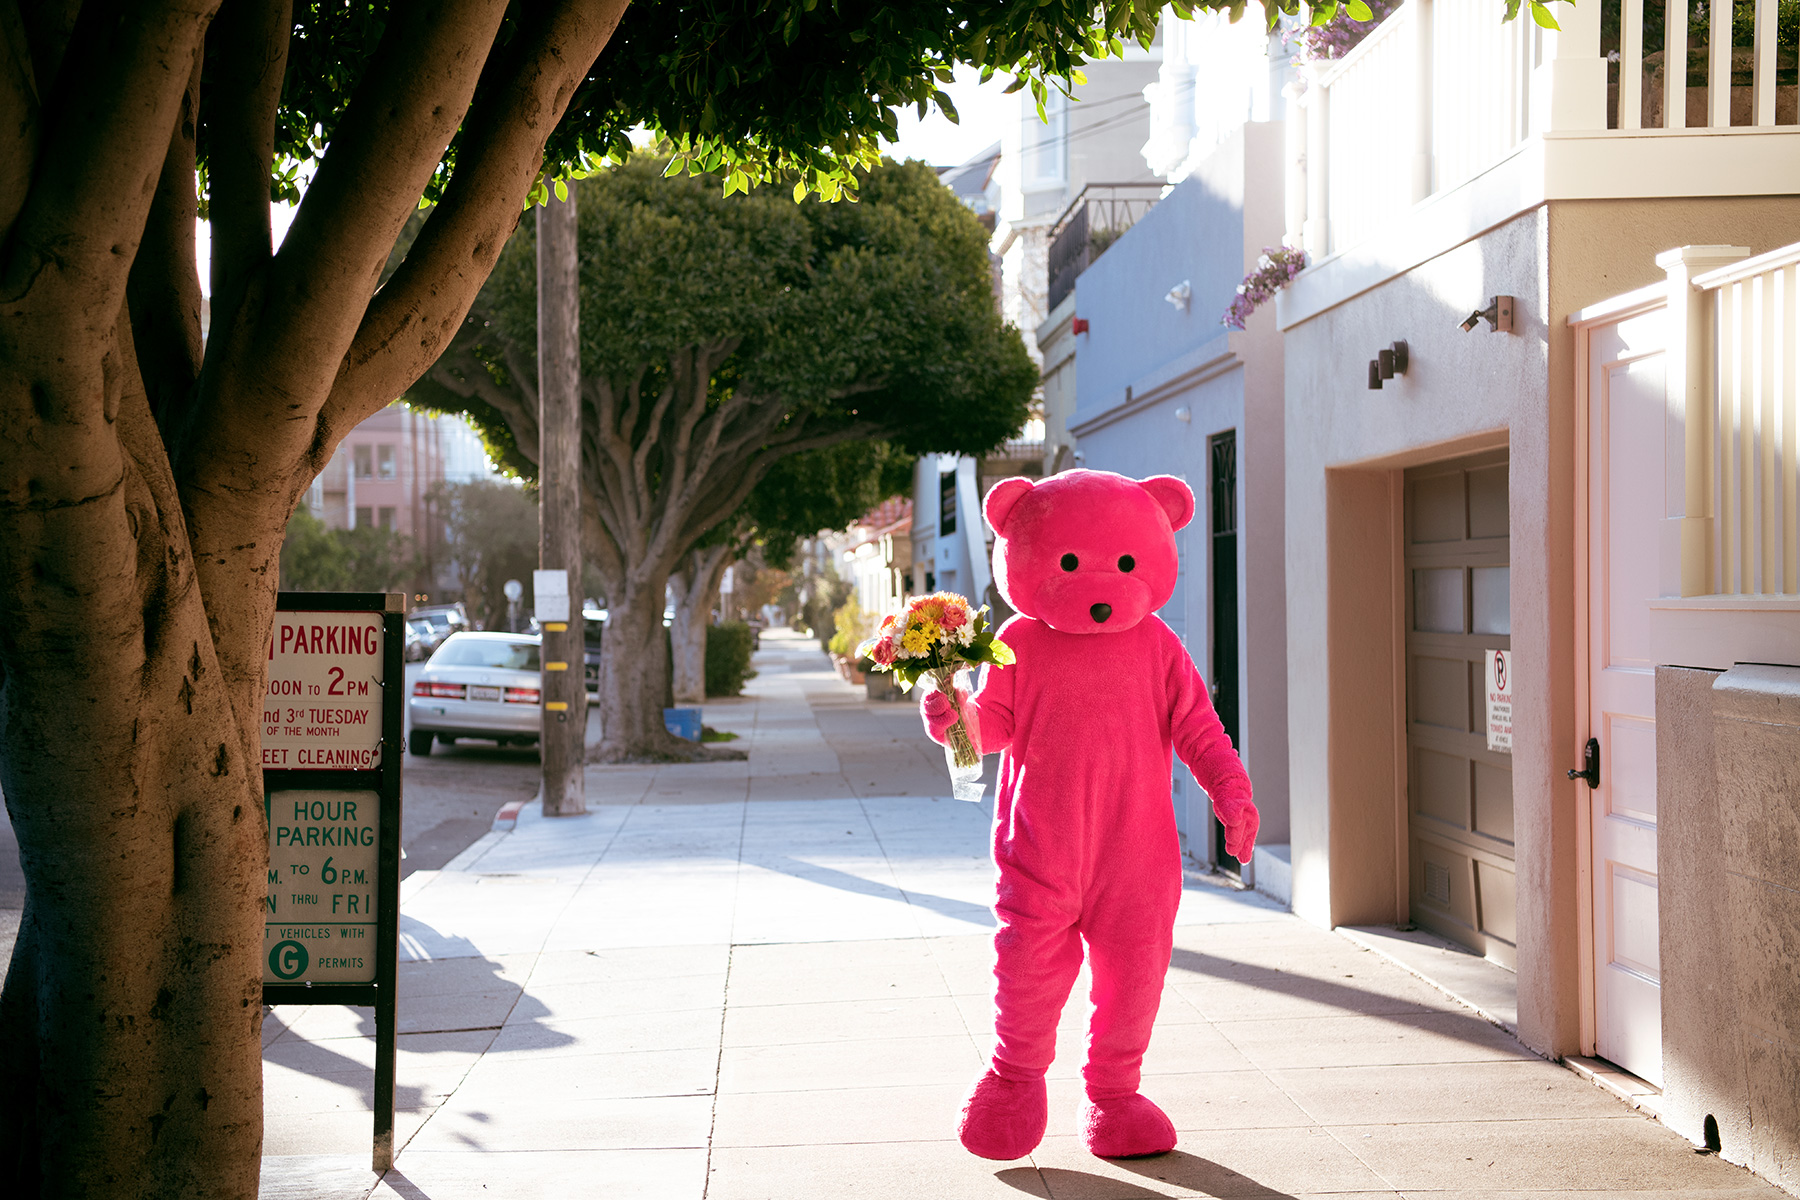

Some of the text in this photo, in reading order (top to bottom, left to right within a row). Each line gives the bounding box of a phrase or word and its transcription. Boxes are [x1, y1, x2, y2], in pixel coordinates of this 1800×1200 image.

[280, 625, 377, 655] PARKING
[308, 685, 321, 696] TO
[263, 708, 369, 724] nd 3rd TUESDAY
[266, 726, 340, 737] OF THE MONTH
[262, 749, 370, 765] EET CLEANING
[294, 801, 358, 821] HOUR
[276, 826, 374, 847] PARKING
[290, 864, 310, 875] TO
[291, 894, 318, 905] THRU
[332, 894, 370, 914] FRI
[280, 928, 331, 939] VEHICLES
[340, 928, 365, 939] WITH
[278, 944, 364, 975] G PERMITS
